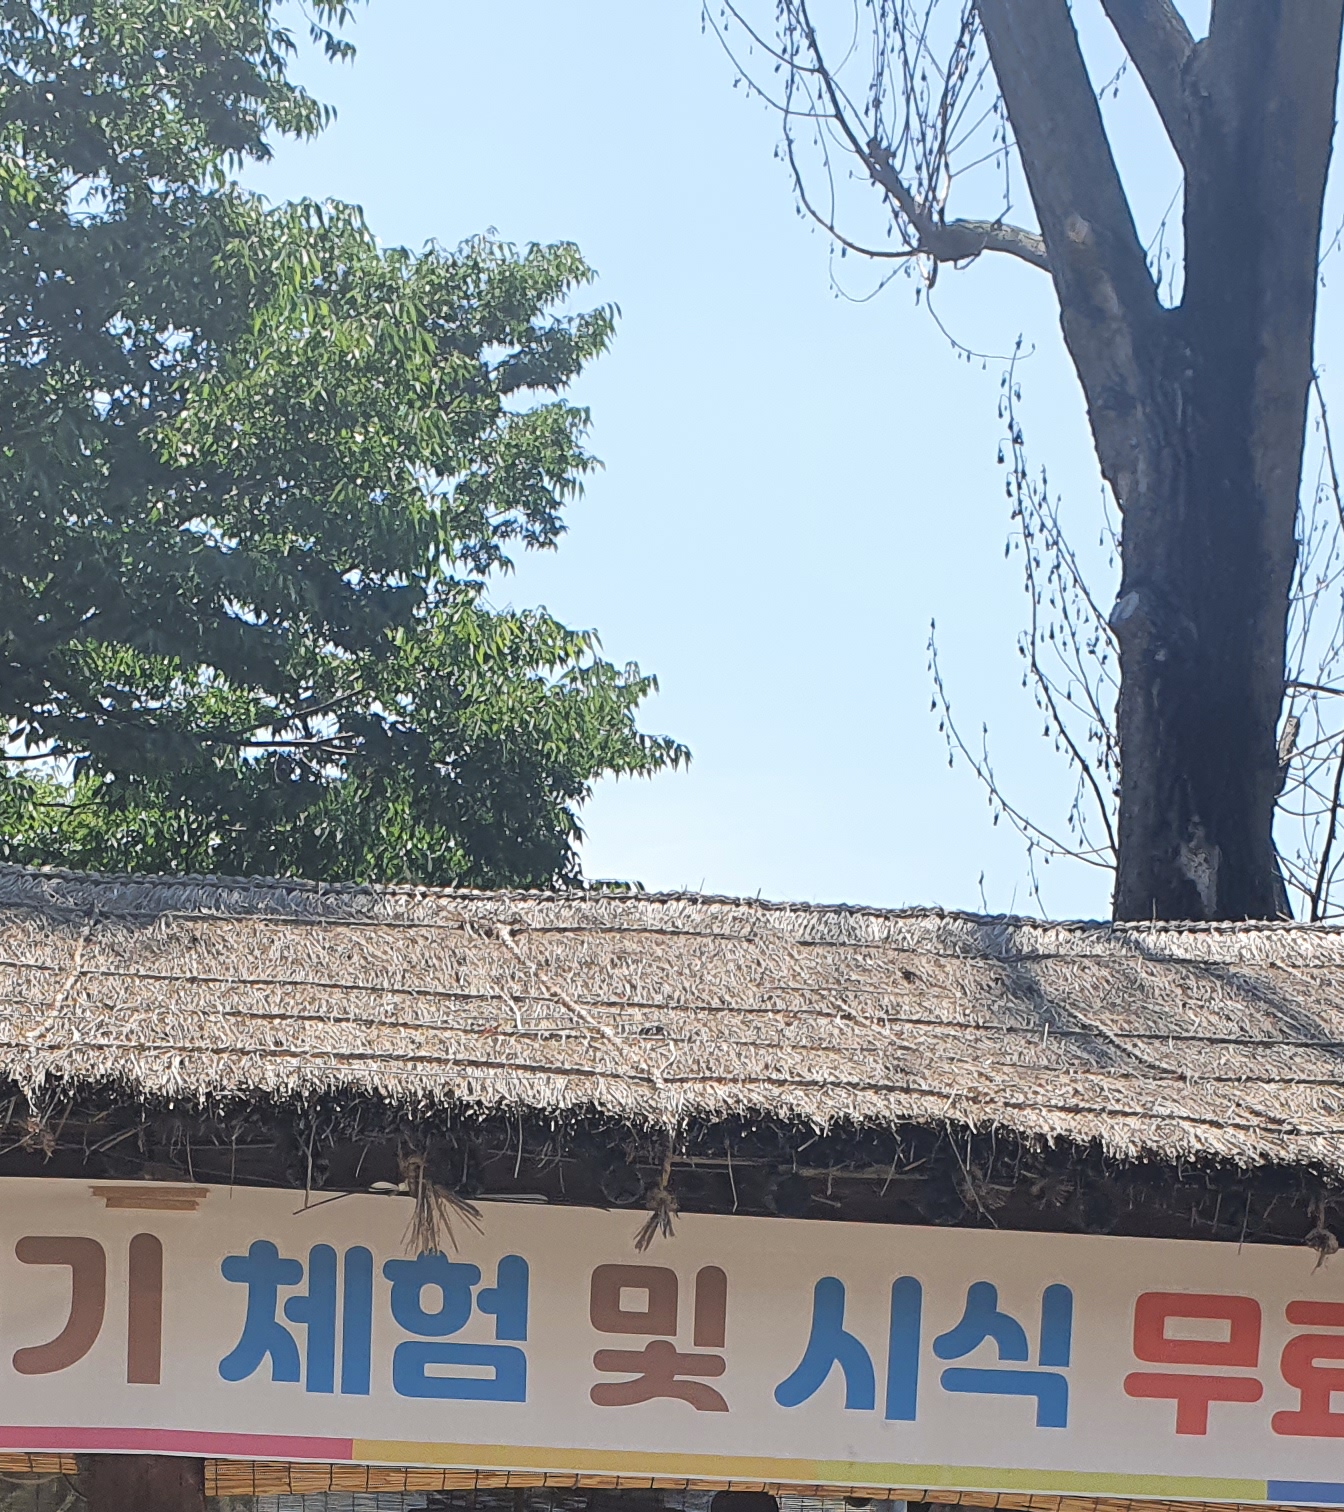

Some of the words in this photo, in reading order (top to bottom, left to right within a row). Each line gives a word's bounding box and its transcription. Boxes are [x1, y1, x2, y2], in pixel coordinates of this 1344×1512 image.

[220, 1240, 529, 1403] 체험
[589, 1263, 730, 1413] 및
[773, 1274, 1074, 1430] 시식
